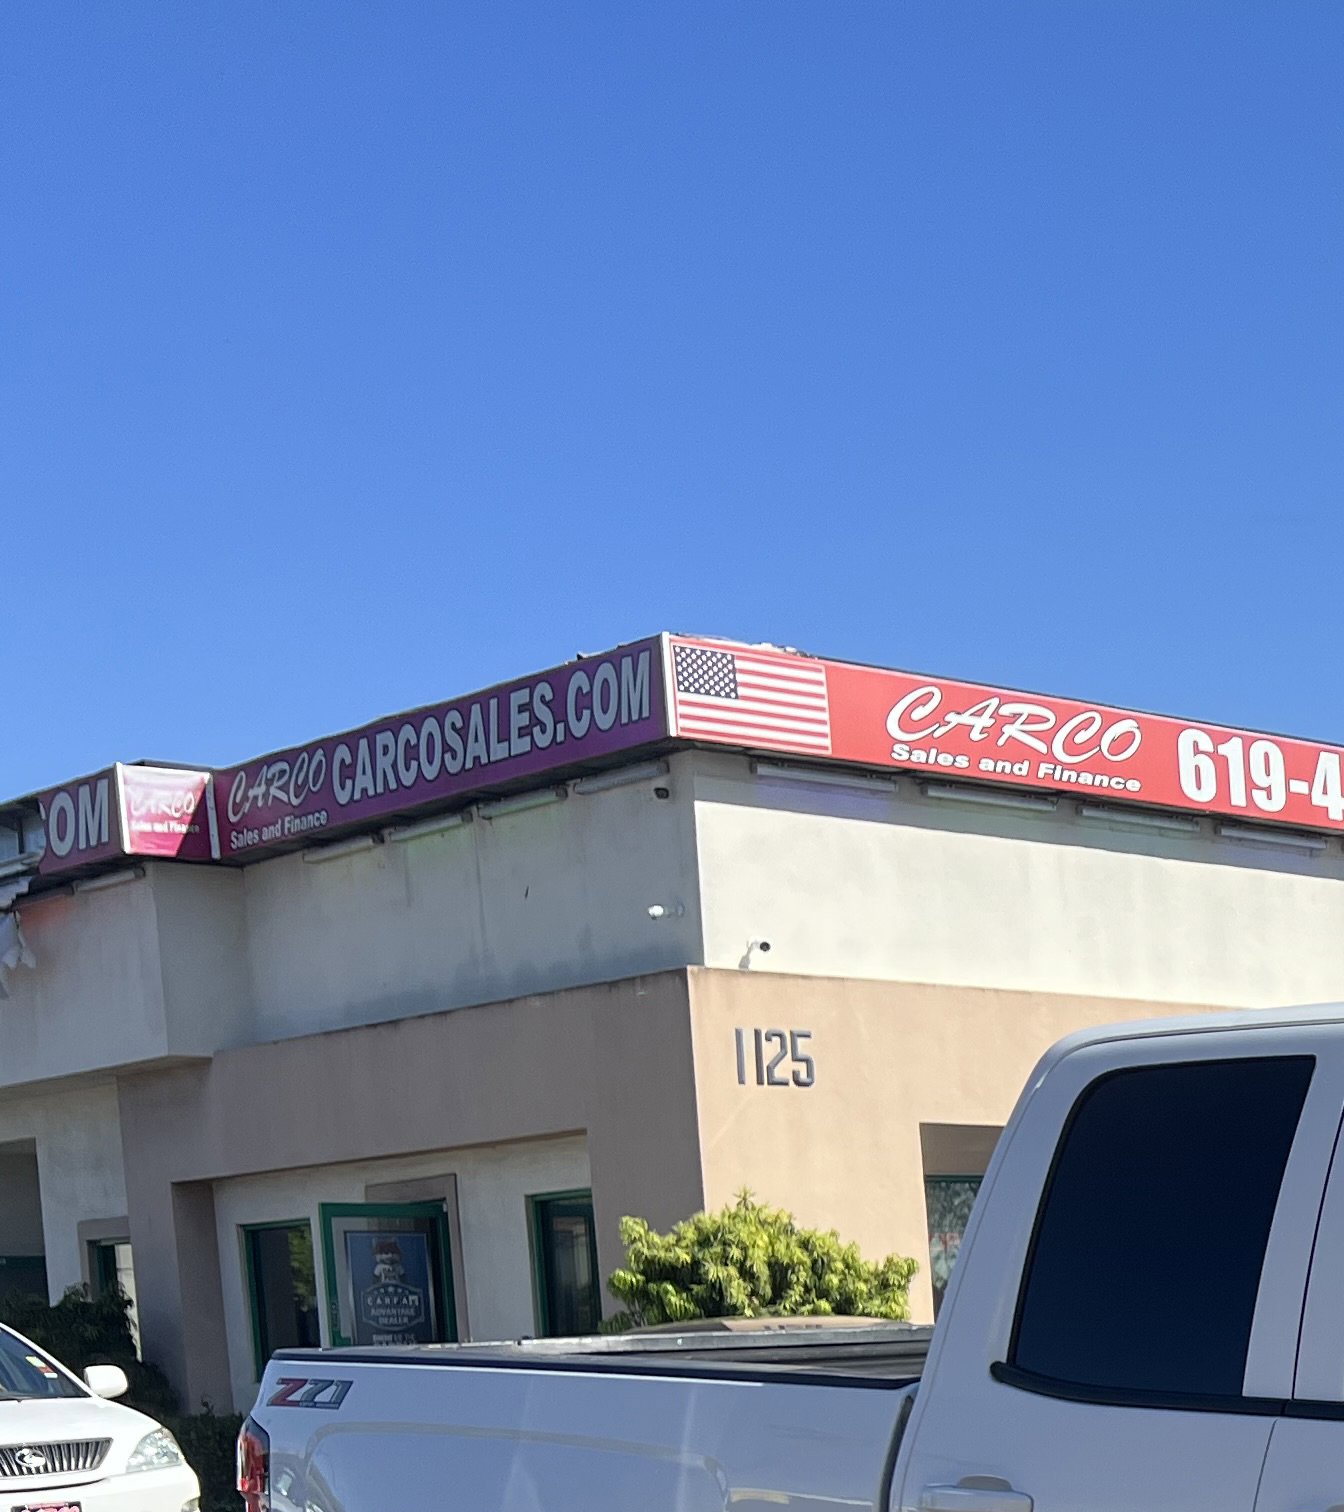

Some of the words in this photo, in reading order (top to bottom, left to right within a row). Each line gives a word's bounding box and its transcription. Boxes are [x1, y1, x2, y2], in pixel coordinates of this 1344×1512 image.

[332, 650, 651, 806] CARCOSALES.COM
[885, 684, 1143, 764] CARCO
[227, 747, 327, 824] CARCO
[891, 742, 970, 766] Sales
[978, 756, 1031, 778] and
[1037, 762, 1143, 793] Finance
[39, 777, 109, 858] OM
[230, 828, 259, 850] Sales
[261, 817, 281, 842] and
[284, 809, 328, 836] Finance
[735, 1027, 815, 1087] 1125
[266, 1377, 354, 1410] Z71
